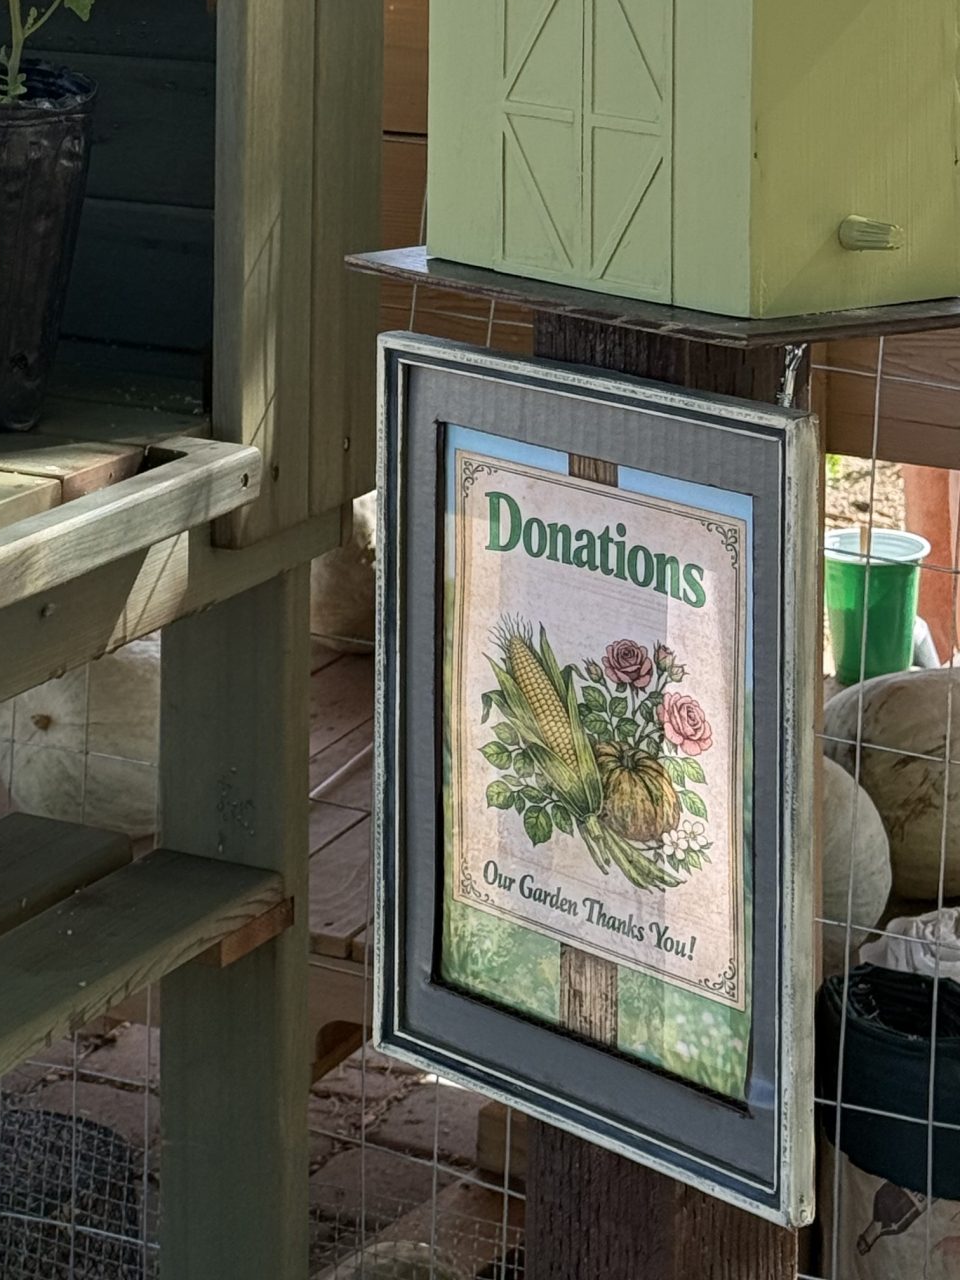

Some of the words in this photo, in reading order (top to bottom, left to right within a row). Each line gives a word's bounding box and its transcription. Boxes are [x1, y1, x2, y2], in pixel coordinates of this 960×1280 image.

[485, 491, 706, 609] Donations
[483, 860, 515, 891] Our
[519, 874, 578, 916] Garden
[582, 897, 645, 942] Thanks
[649, 922, 697, 961] You!
